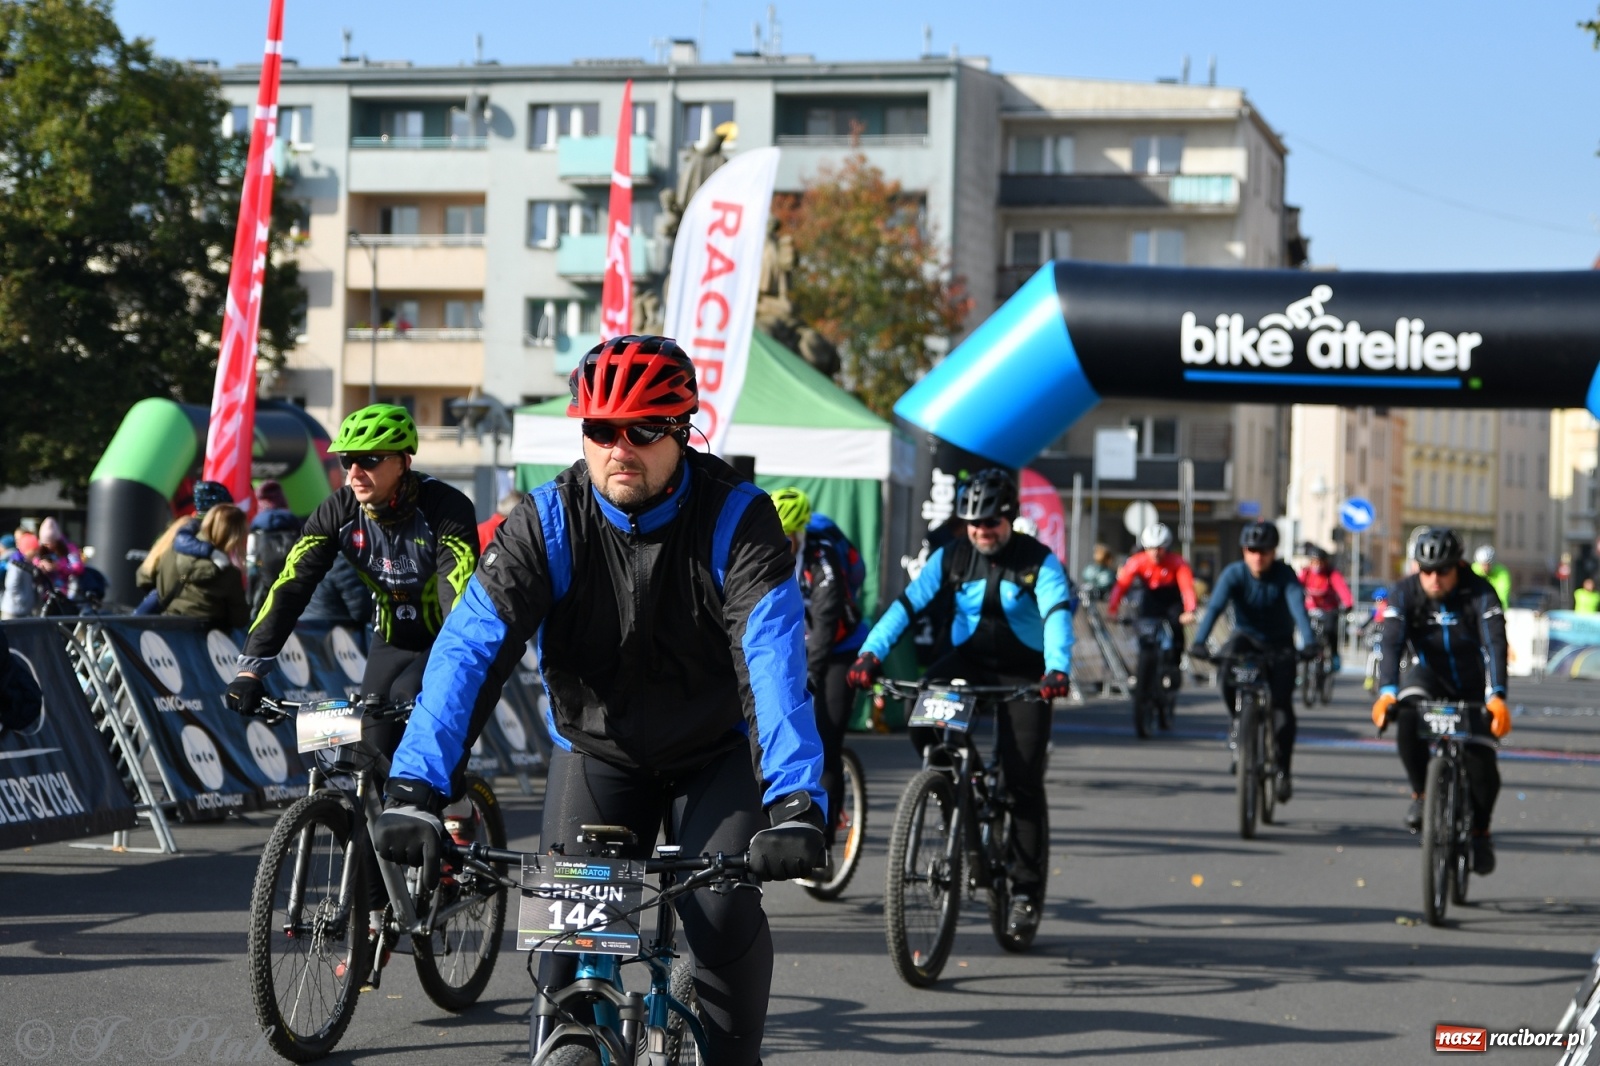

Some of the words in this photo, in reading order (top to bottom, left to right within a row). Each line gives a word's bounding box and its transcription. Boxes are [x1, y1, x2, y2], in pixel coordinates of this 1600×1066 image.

[1180, 311, 1294, 368] bike
[1306, 315, 1483, 372] atelier
[548, 900, 608, 932] 146
